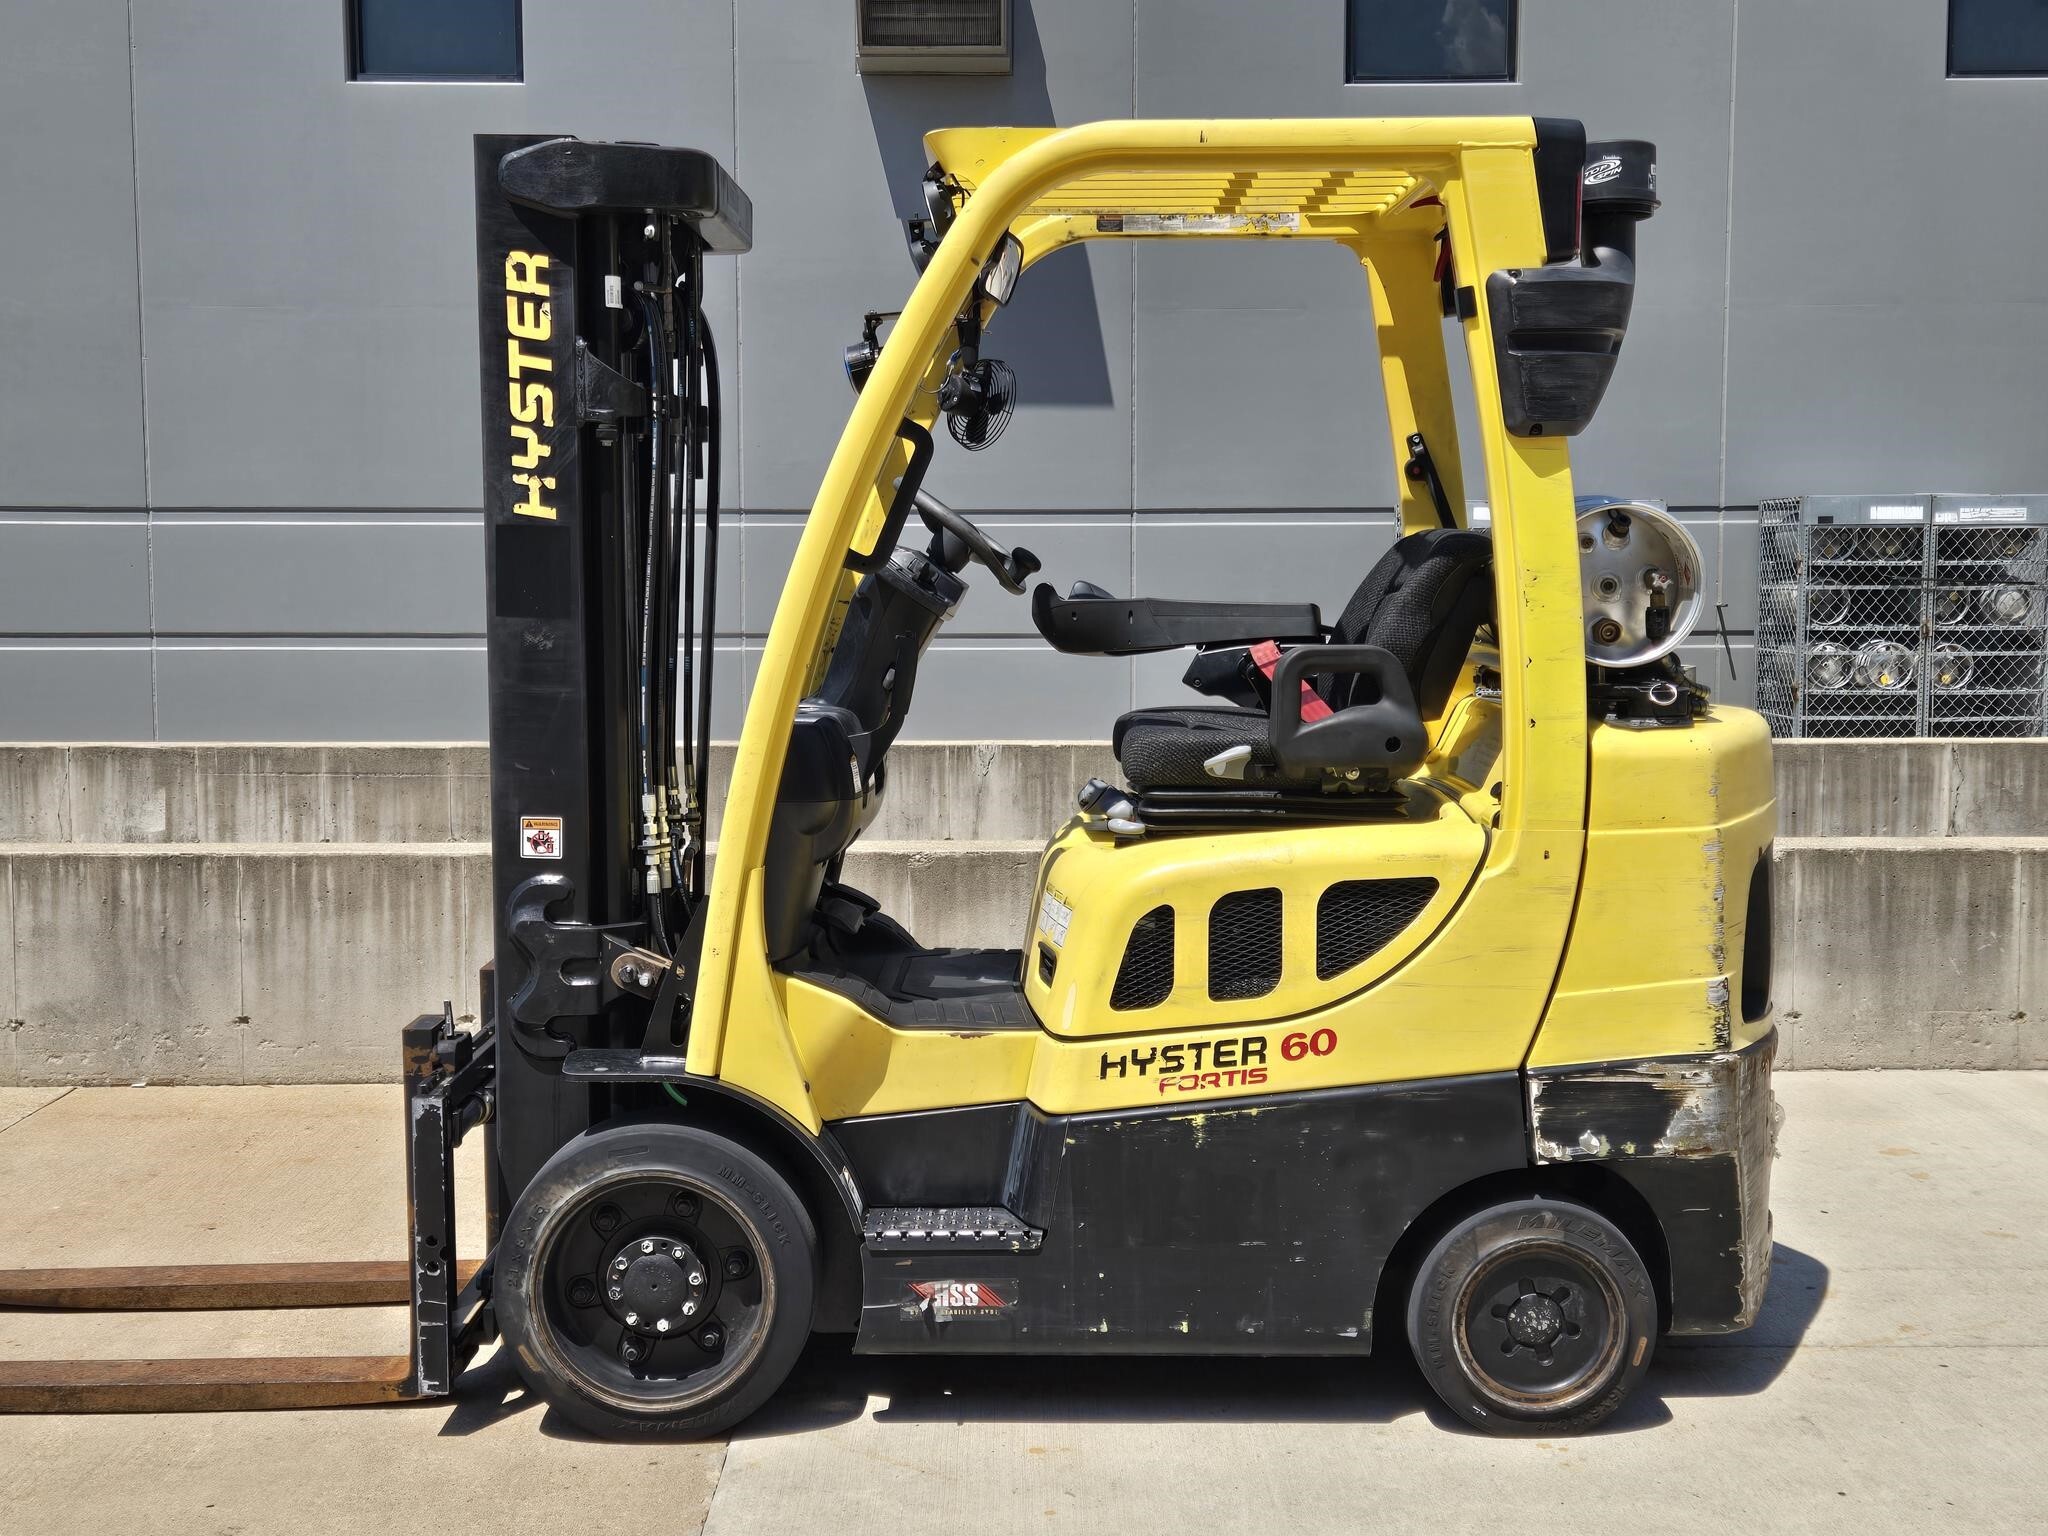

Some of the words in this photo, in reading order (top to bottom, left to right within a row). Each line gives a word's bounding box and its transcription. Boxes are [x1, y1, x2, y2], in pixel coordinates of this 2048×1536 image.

[1584, 164, 1608, 178] TOP
[1597, 166, 1622, 180] SPIN
[505, 250, 557, 520] HYSTER
[1099, 1036, 1267, 1080] HYSTER
[1281, 1028, 1338, 1062] 60
[1158, 1067, 1268, 1095] FORTIS
[934, 1282, 979, 1307] HSS
